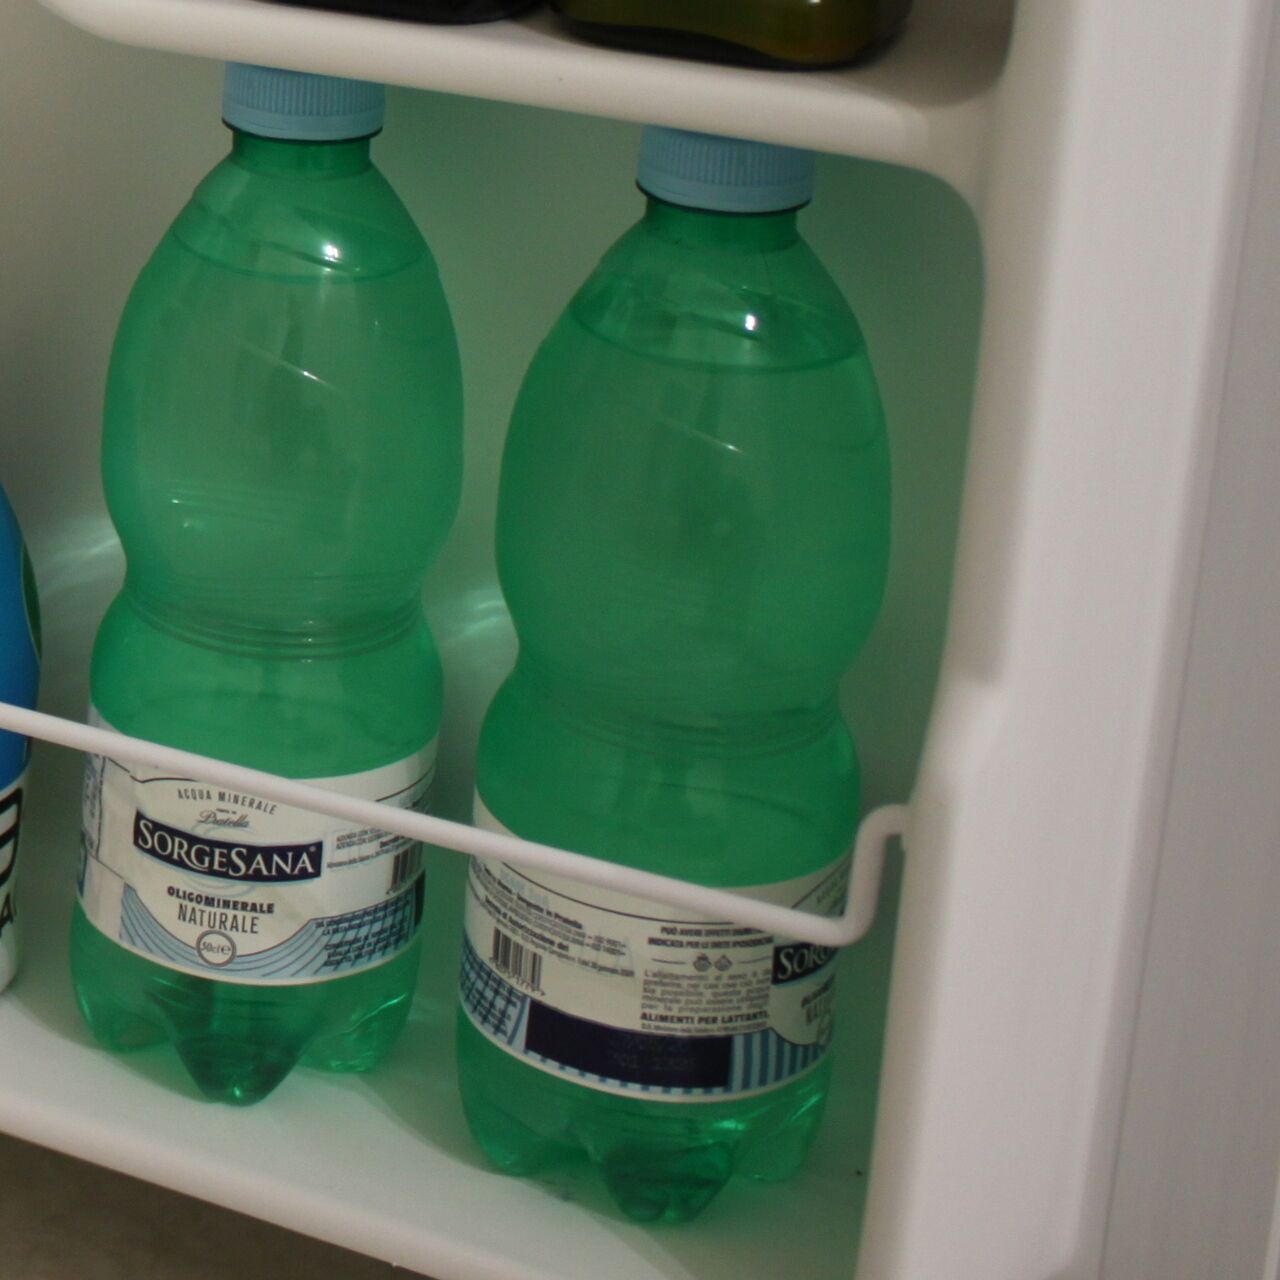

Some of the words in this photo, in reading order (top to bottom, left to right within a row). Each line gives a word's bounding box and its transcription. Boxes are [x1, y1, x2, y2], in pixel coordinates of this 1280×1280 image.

[177, 788, 212, 801] ACQUA
[218, 791, 277, 816] MINERALE
[167, 885, 276, 914] OLIGOMINERALE
[177, 902, 260, 935] NATURALE
[640, 1011, 696, 1025] ALIMENTI
[697, 1015, 718, 1025] PER
